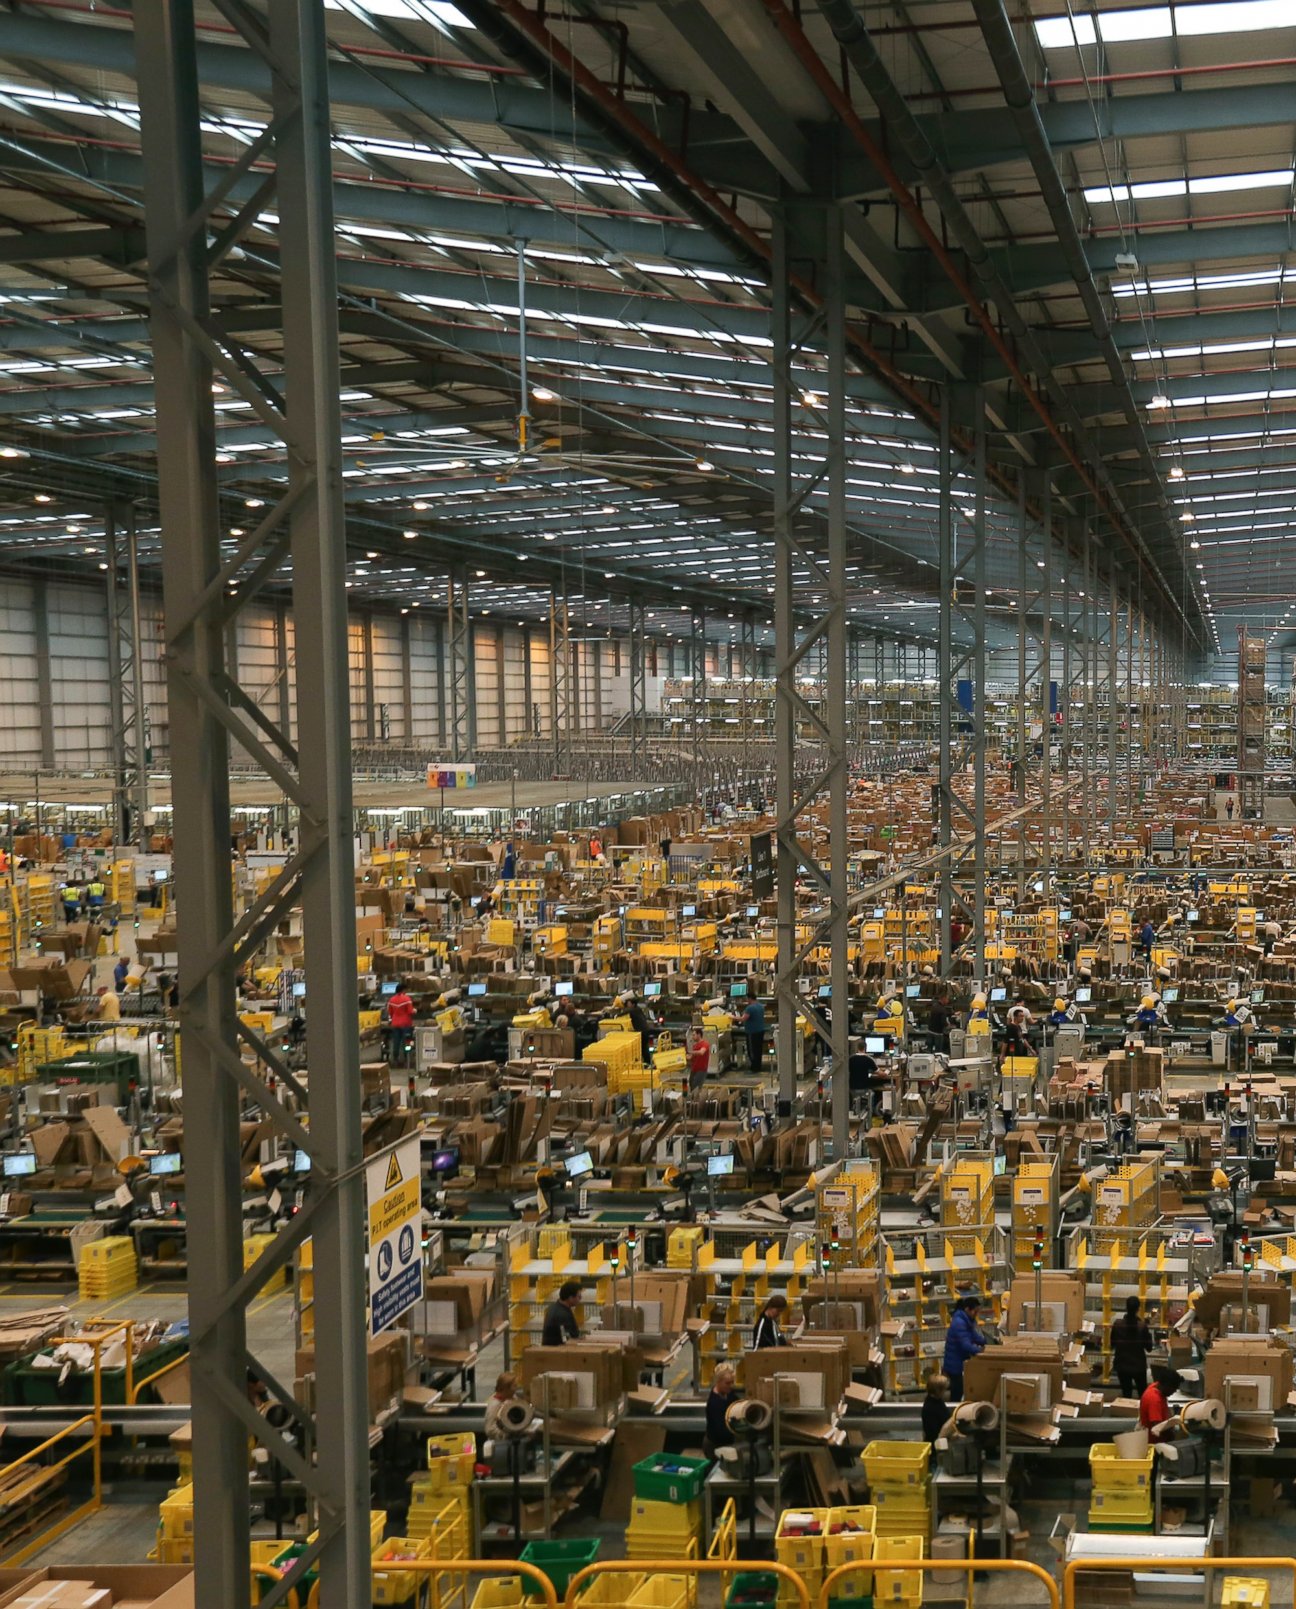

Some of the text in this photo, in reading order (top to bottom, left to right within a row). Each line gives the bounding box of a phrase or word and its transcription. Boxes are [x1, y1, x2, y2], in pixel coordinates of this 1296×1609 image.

[383, 1191, 405, 1212] Caution
[383, 1206, 406, 1228] operating
[407, 1198, 418, 1211] area
[378, 1288, 391, 1302] Safety
[407, 1266, 416, 1278] and
